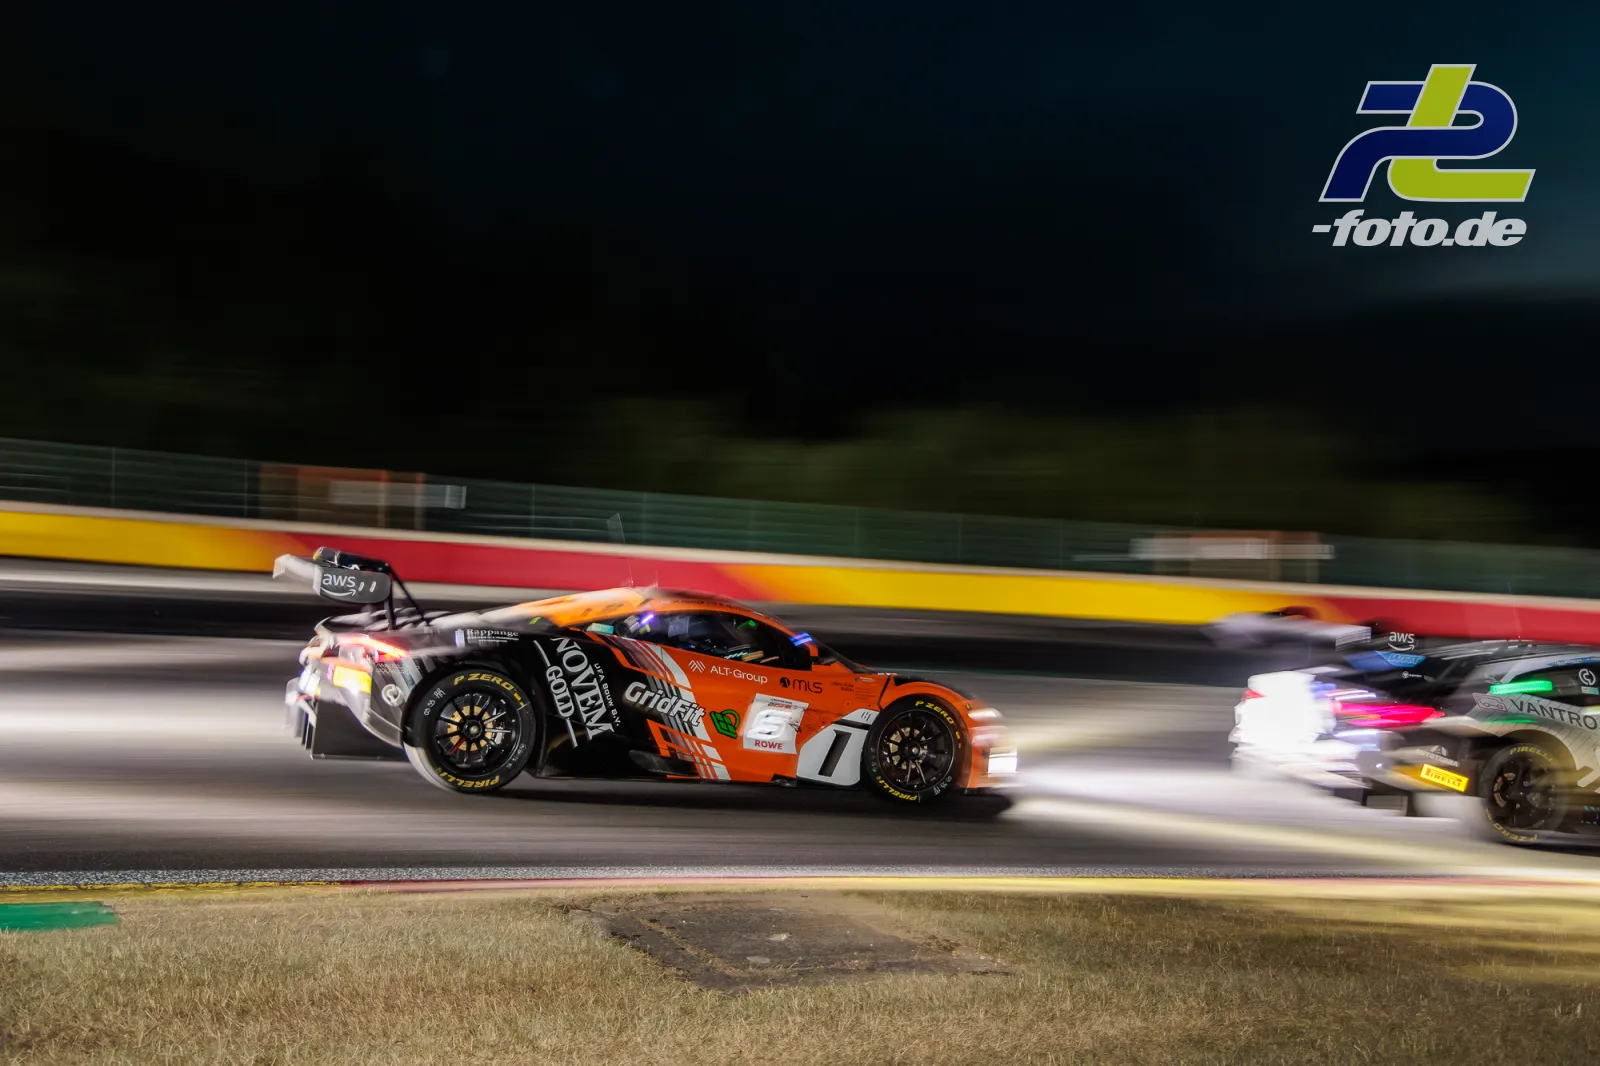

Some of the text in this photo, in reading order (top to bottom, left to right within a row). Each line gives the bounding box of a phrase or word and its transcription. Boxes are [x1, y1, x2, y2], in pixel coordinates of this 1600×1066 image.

[322, 573, 356, 588] aws
[466, 628, 519, 638] Rappange
[1388, 631, 1415, 644] aws
[453, 673, 515, 691] P ZERO
[594, 662, 606, 682] UFA
[710, 665, 768, 685] ALT-Group
[546, 665, 575, 718] GOLD
[550, 637, 615, 741] NOVEM
[624, 681, 706, 727] GridFit
[925, 702, 955, 725] ZERO
[754, 739, 783, 750] ROWE
[439, 771, 500, 788] PIRELLI
[878, 778, 917, 801] PIRELLI
